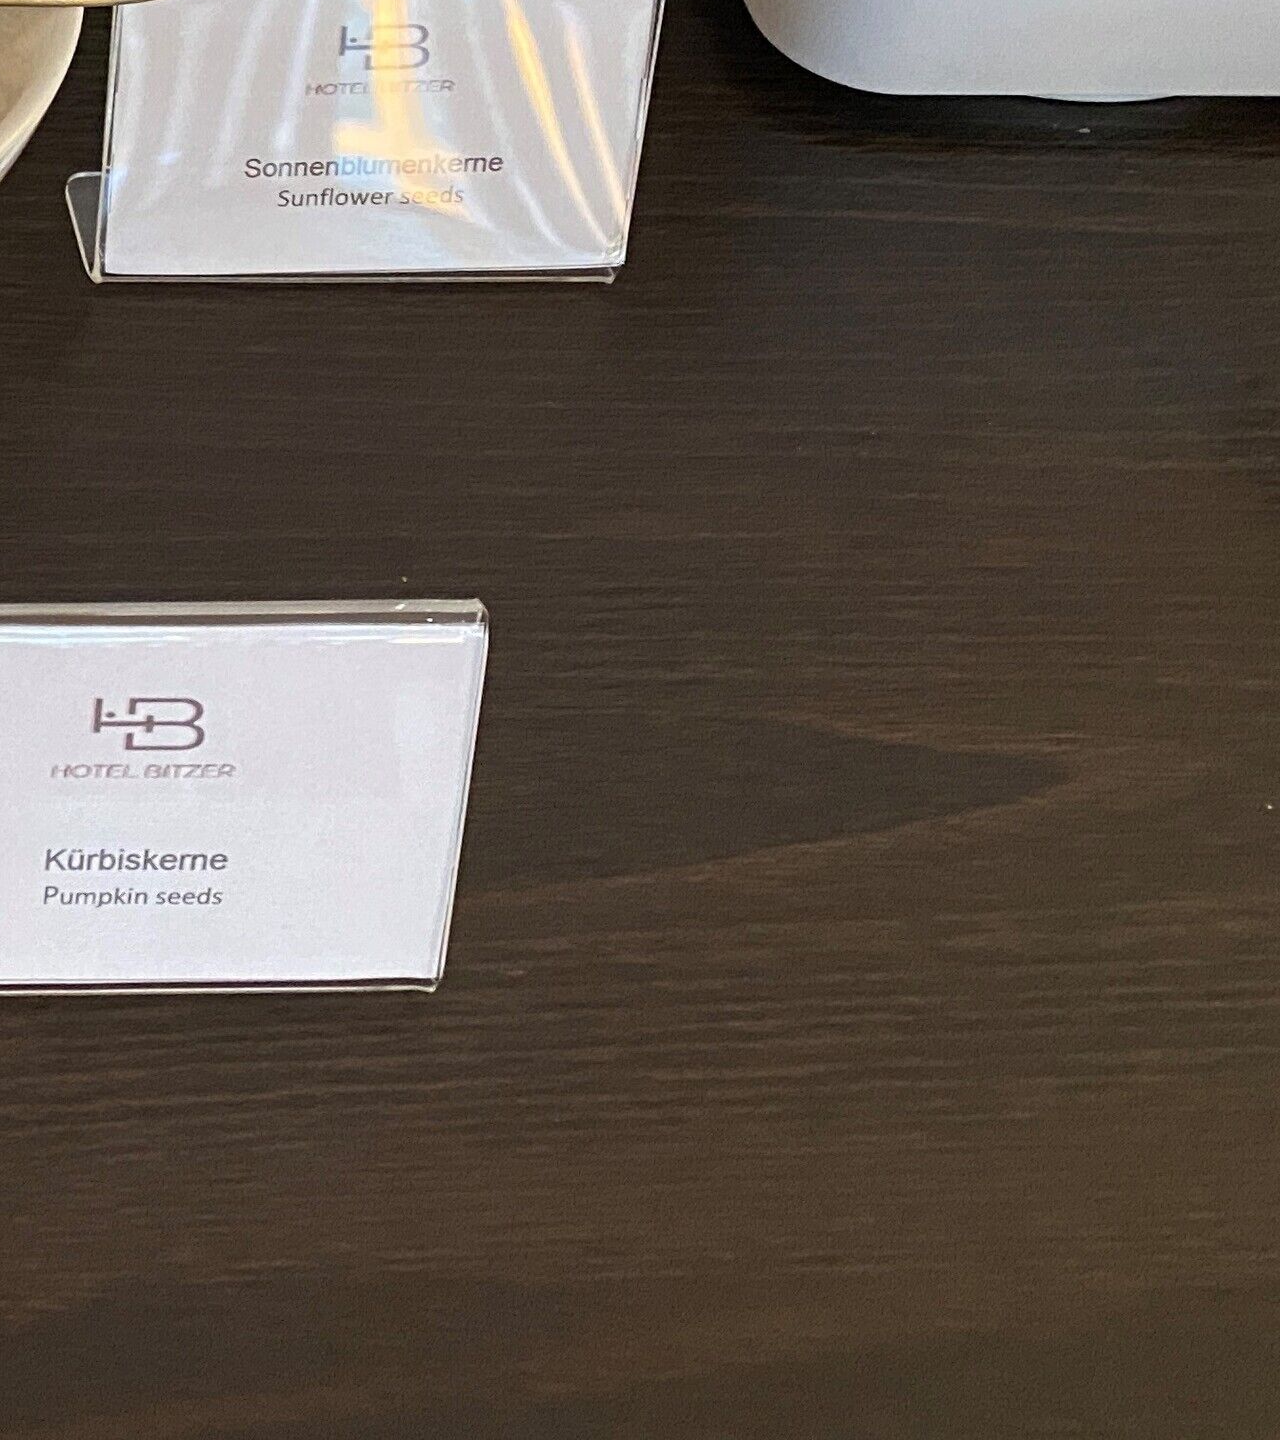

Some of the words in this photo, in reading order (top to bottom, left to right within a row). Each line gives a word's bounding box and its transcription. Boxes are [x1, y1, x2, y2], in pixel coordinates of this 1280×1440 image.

[380, 80, 456, 94] ITZER
[244, 153, 504, 179] Sonnenblumenkerne
[277, 187, 395, 208] Sunflower
[400, 185, 465, 205] seeds
[50, 763, 139, 779] HOTEL
[144, 763, 237, 779] BITZER
[44, 847, 229, 872] Kürbiskerne
[42, 885, 150, 909] Pumpkin
[155, 885, 223, 906] seeds
